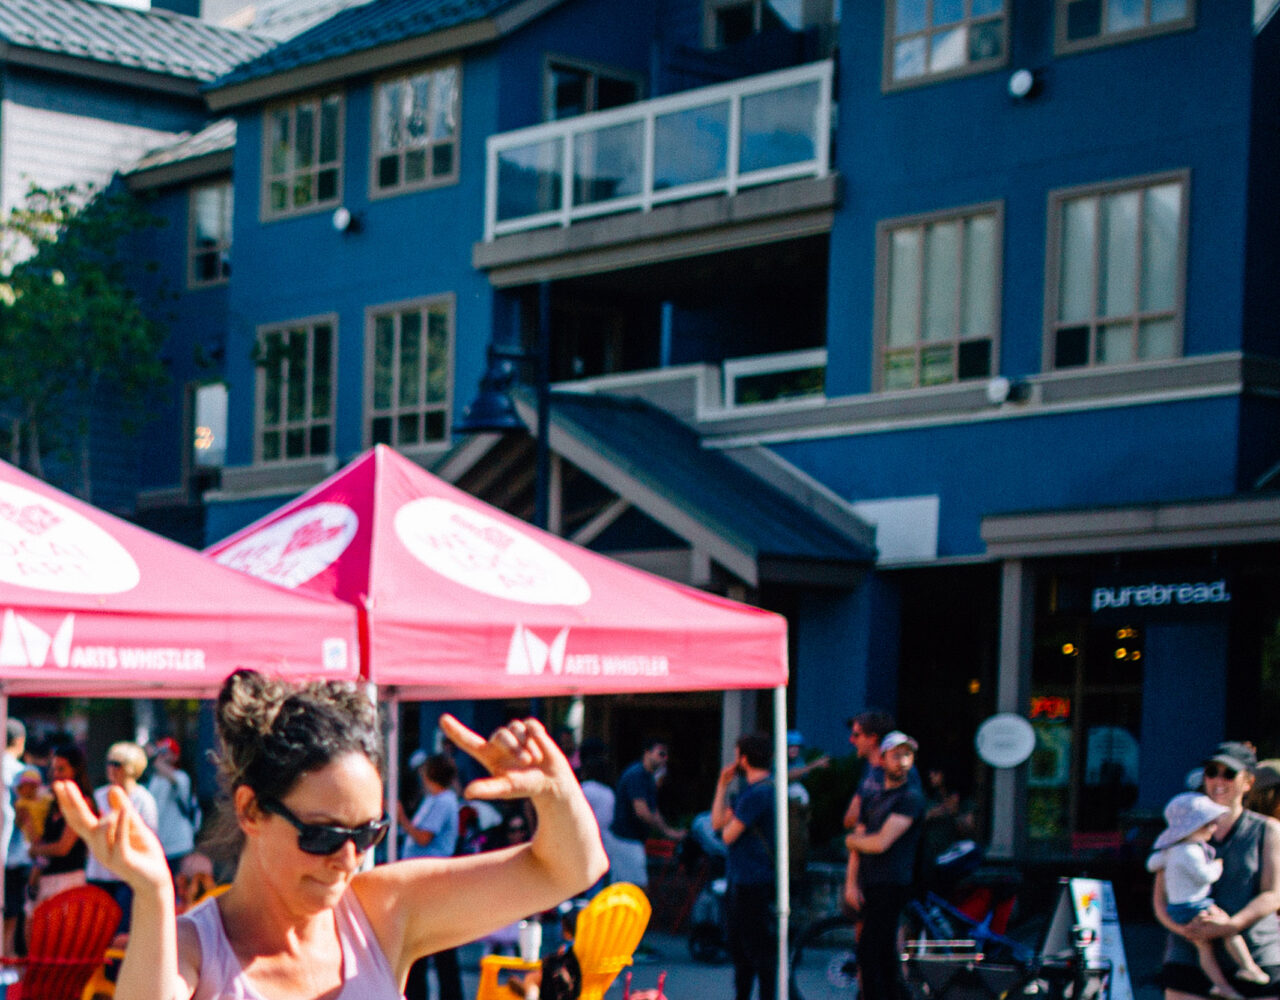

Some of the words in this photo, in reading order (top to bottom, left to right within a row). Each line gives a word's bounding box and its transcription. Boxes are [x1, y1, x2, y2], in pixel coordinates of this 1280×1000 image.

[1093, 579, 1231, 612] purebread.
[71, 646, 117, 669] ARTS
[119, 647, 206, 670] WHISTLER
[565, 654, 600, 675] ARTS
[602, 655, 669, 676] WHISTLER
